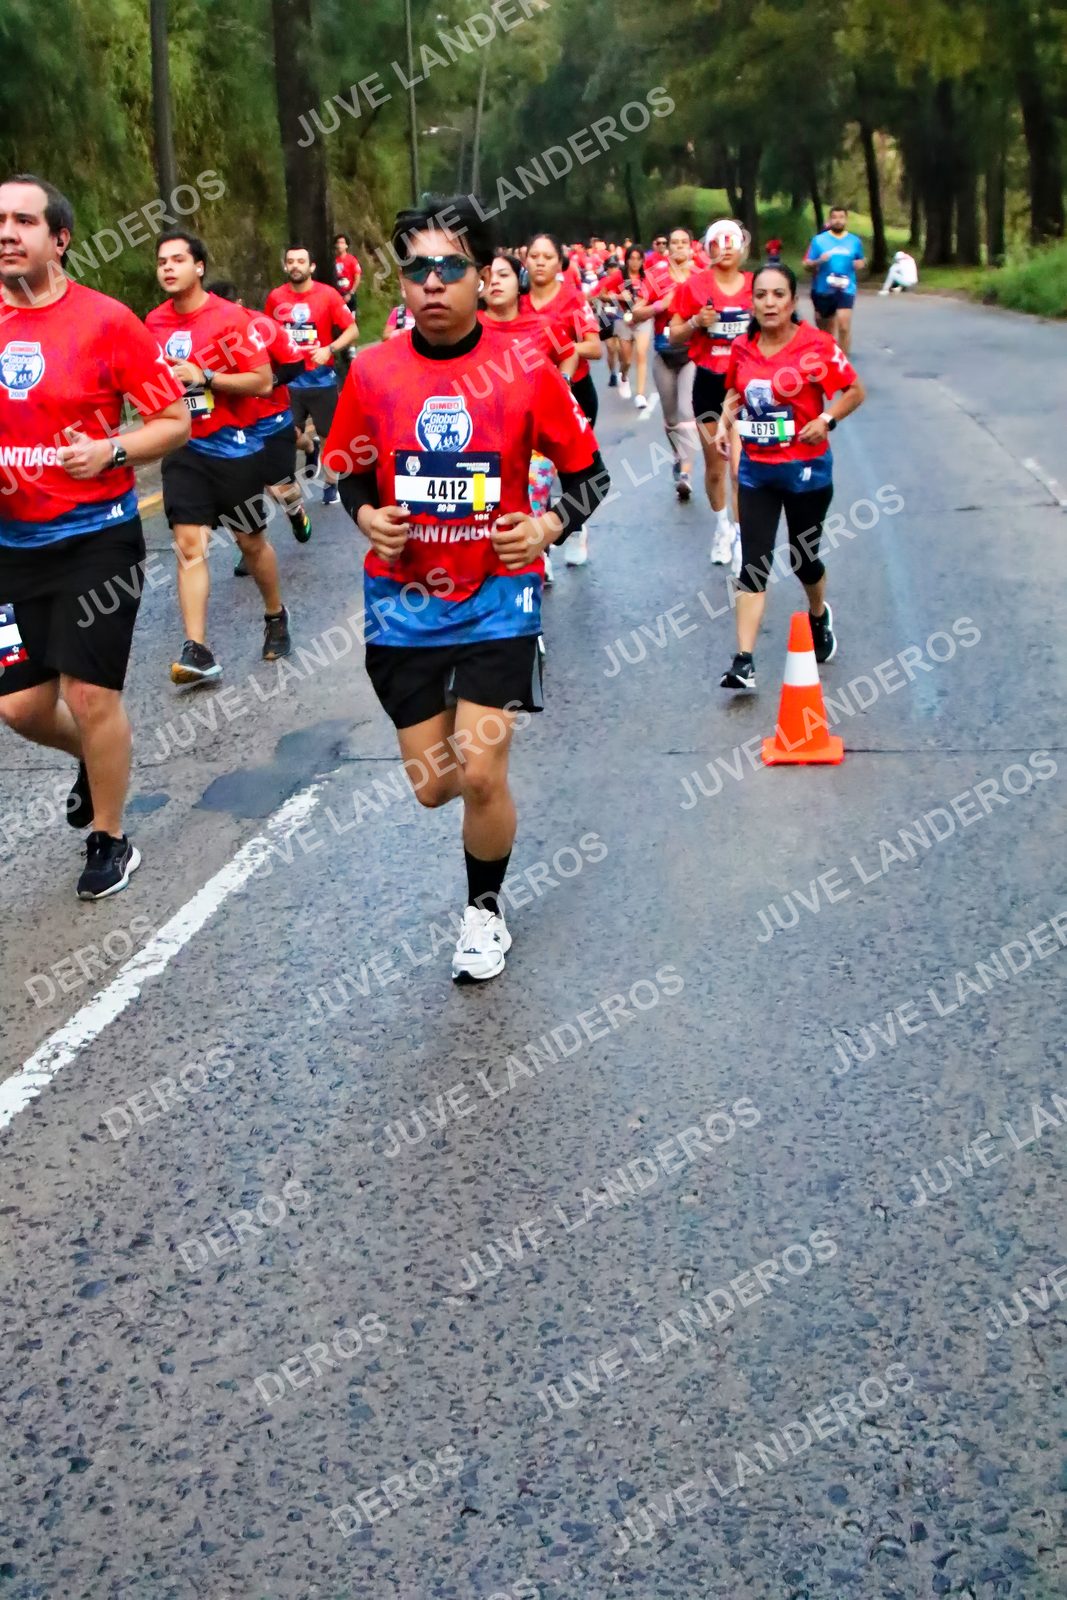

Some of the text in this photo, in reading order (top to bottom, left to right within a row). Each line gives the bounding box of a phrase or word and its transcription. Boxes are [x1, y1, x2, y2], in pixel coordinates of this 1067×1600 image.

[429, 413, 459, 424] Global
[424, 423, 447, 433] Race
[751, 423, 775, 435] 4679
[427, 479, 467, 501] 4412
